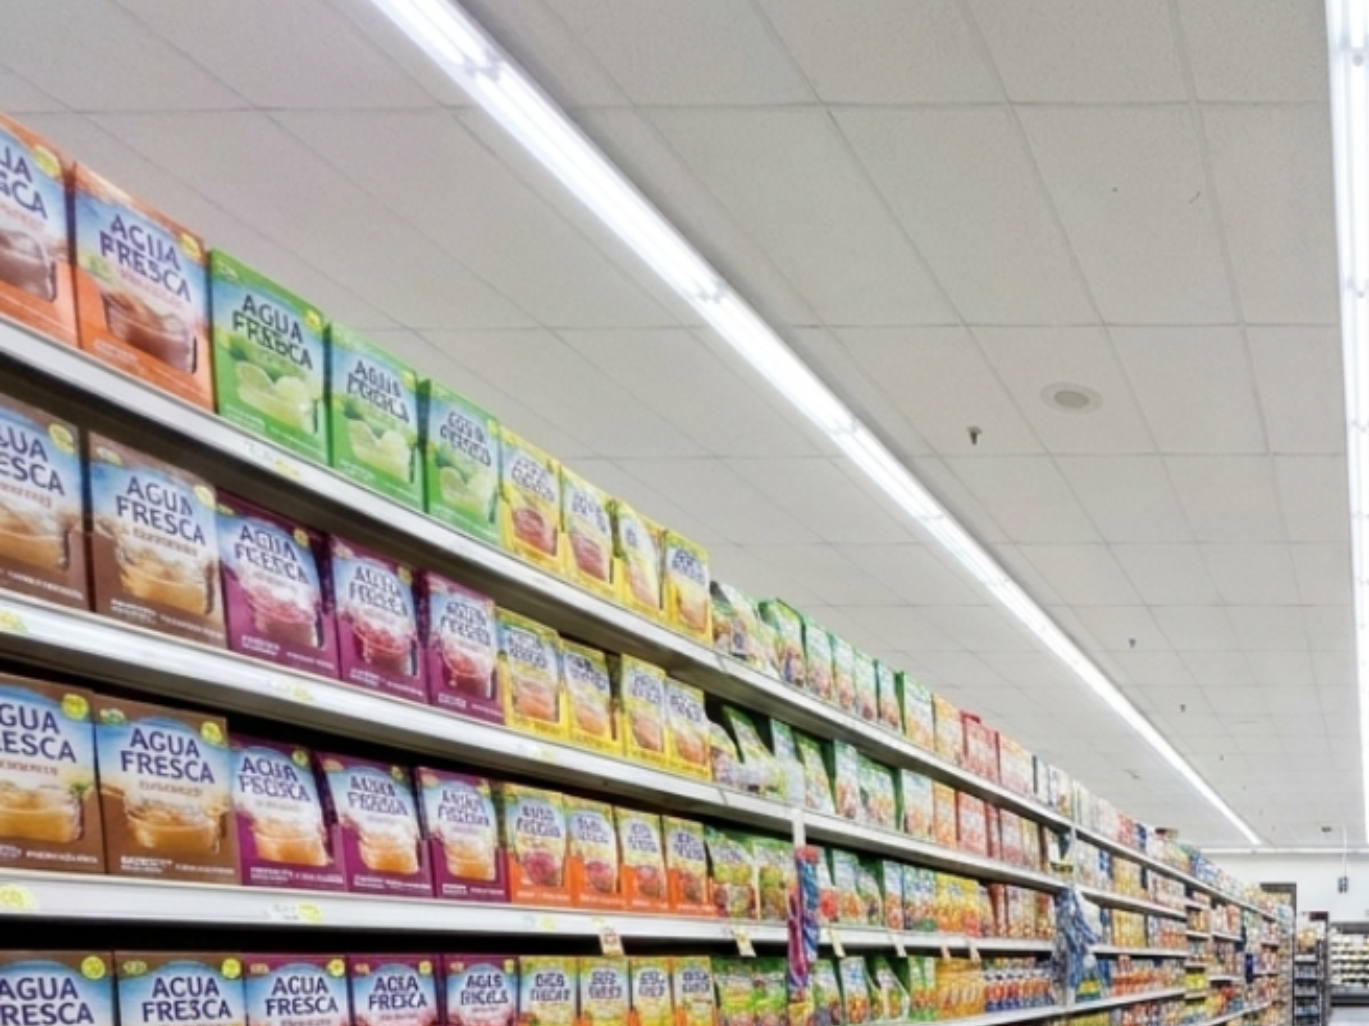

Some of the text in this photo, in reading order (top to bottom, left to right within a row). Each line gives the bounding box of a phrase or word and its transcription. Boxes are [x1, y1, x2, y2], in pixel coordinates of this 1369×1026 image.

[243, 294, 303, 344] AGUA
[117, 496, 206, 546] FRESCA
[0, 731, 78, 763] ESCA
[130, 727, 200, 758] AGUA
[120, 750, 215, 784] FRESCA
[0, 977, 78, 1000] AGUA
[143, 999, 232, 1022] FRESCA
[265, 998, 338, 1017] FRESCA
